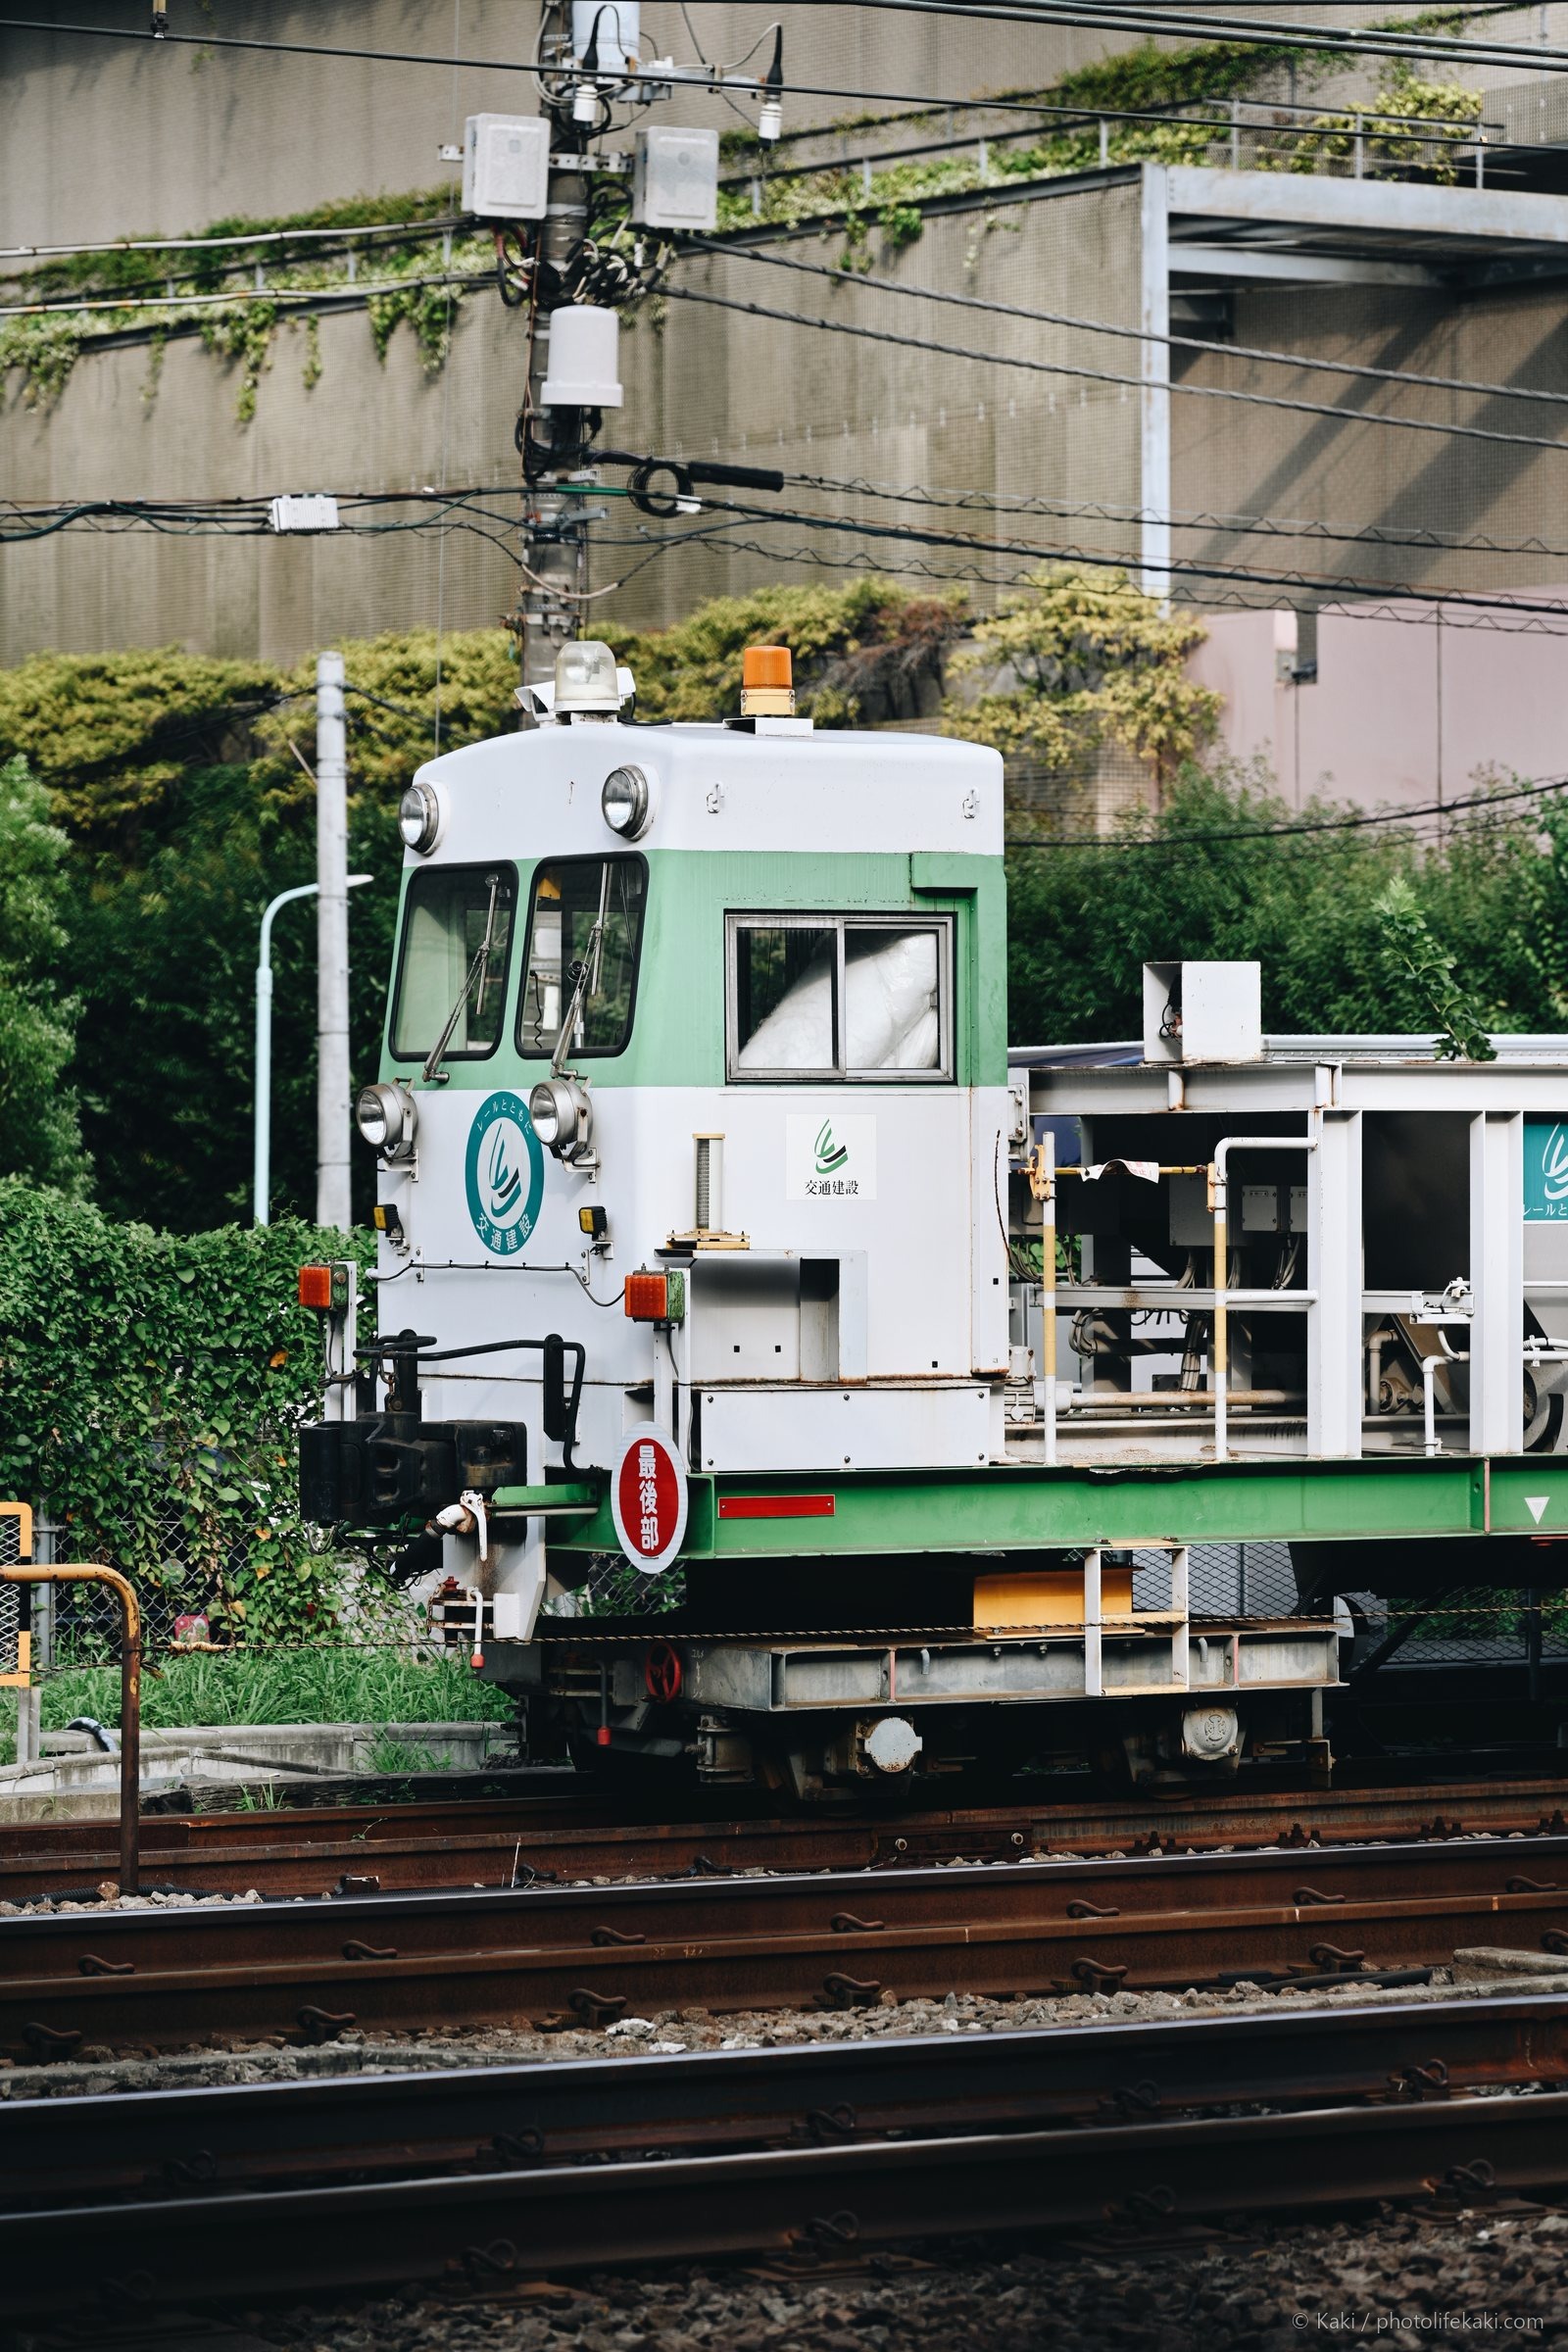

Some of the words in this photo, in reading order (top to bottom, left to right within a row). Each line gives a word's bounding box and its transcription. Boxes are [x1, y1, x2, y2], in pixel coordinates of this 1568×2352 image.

[476, 1099, 532, 1135] レールとともに
[805, 1179, 859, 1196] 交通建設
[476, 1212, 532, 1251] 交通建設
[638, 1445, 660, 1550] 最後部
